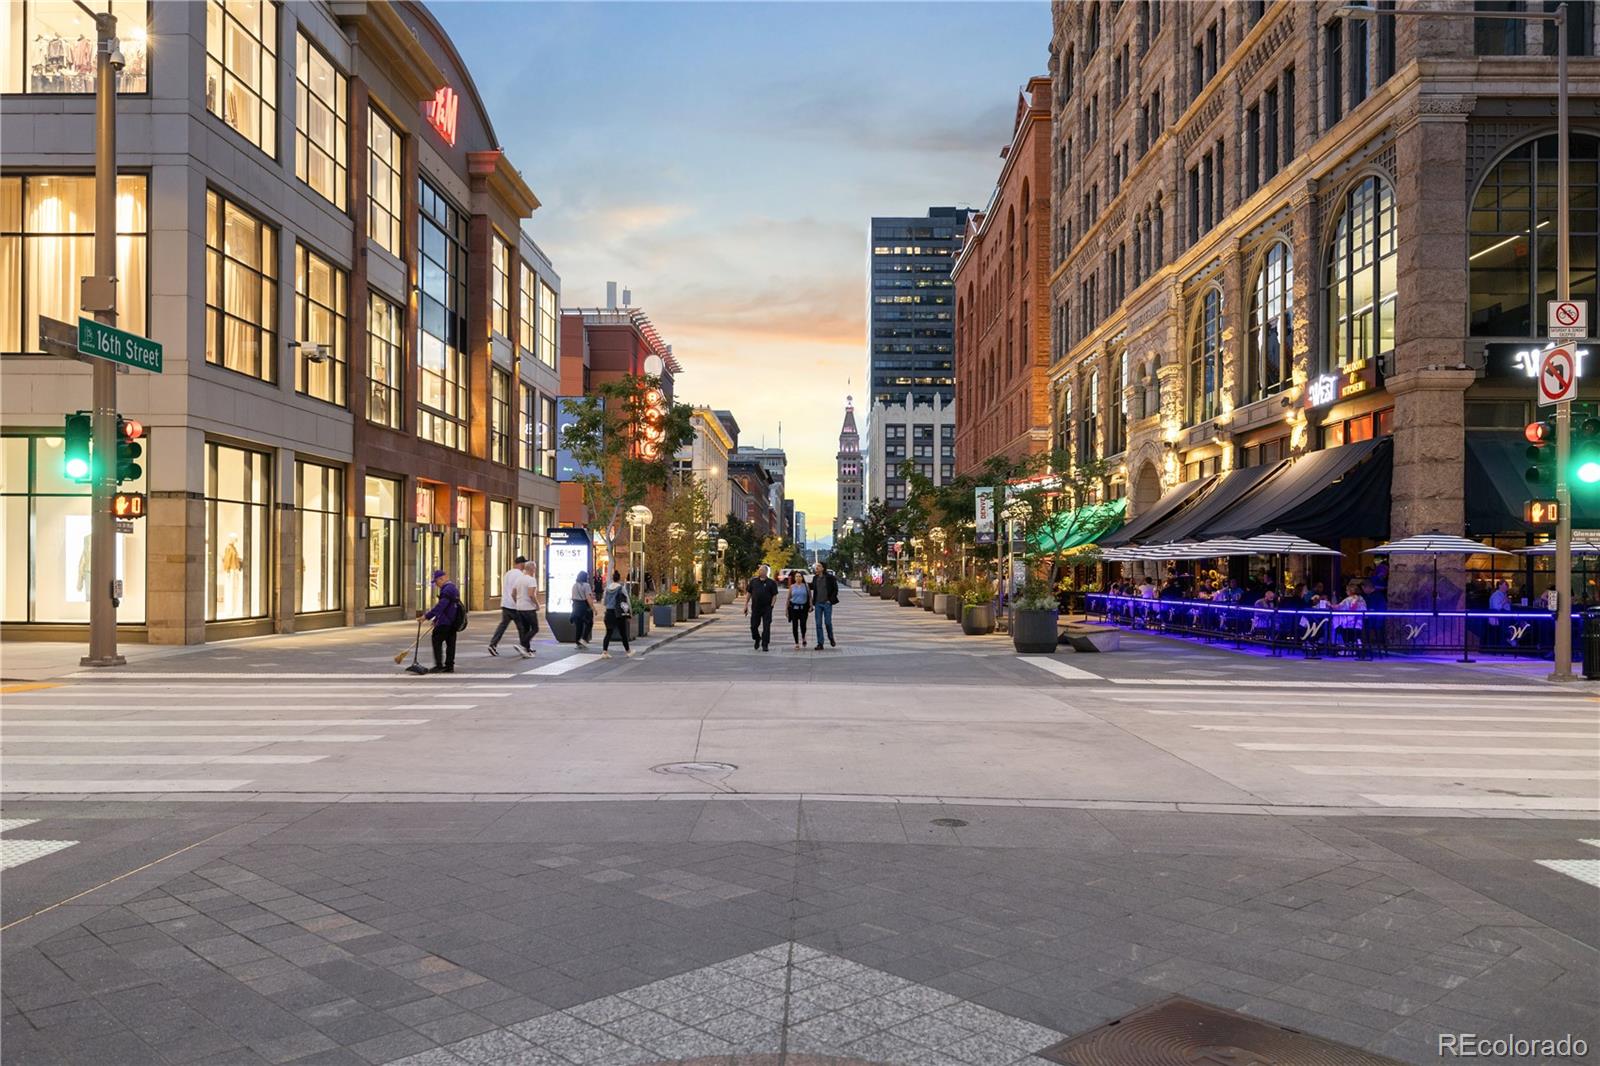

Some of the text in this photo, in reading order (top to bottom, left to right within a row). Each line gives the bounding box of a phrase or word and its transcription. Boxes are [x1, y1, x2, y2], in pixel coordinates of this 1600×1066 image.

[96, 330, 160, 367] 16th Street
[1511, 342, 1589, 377] WT
[1548, 503, 1558, 521] 10
